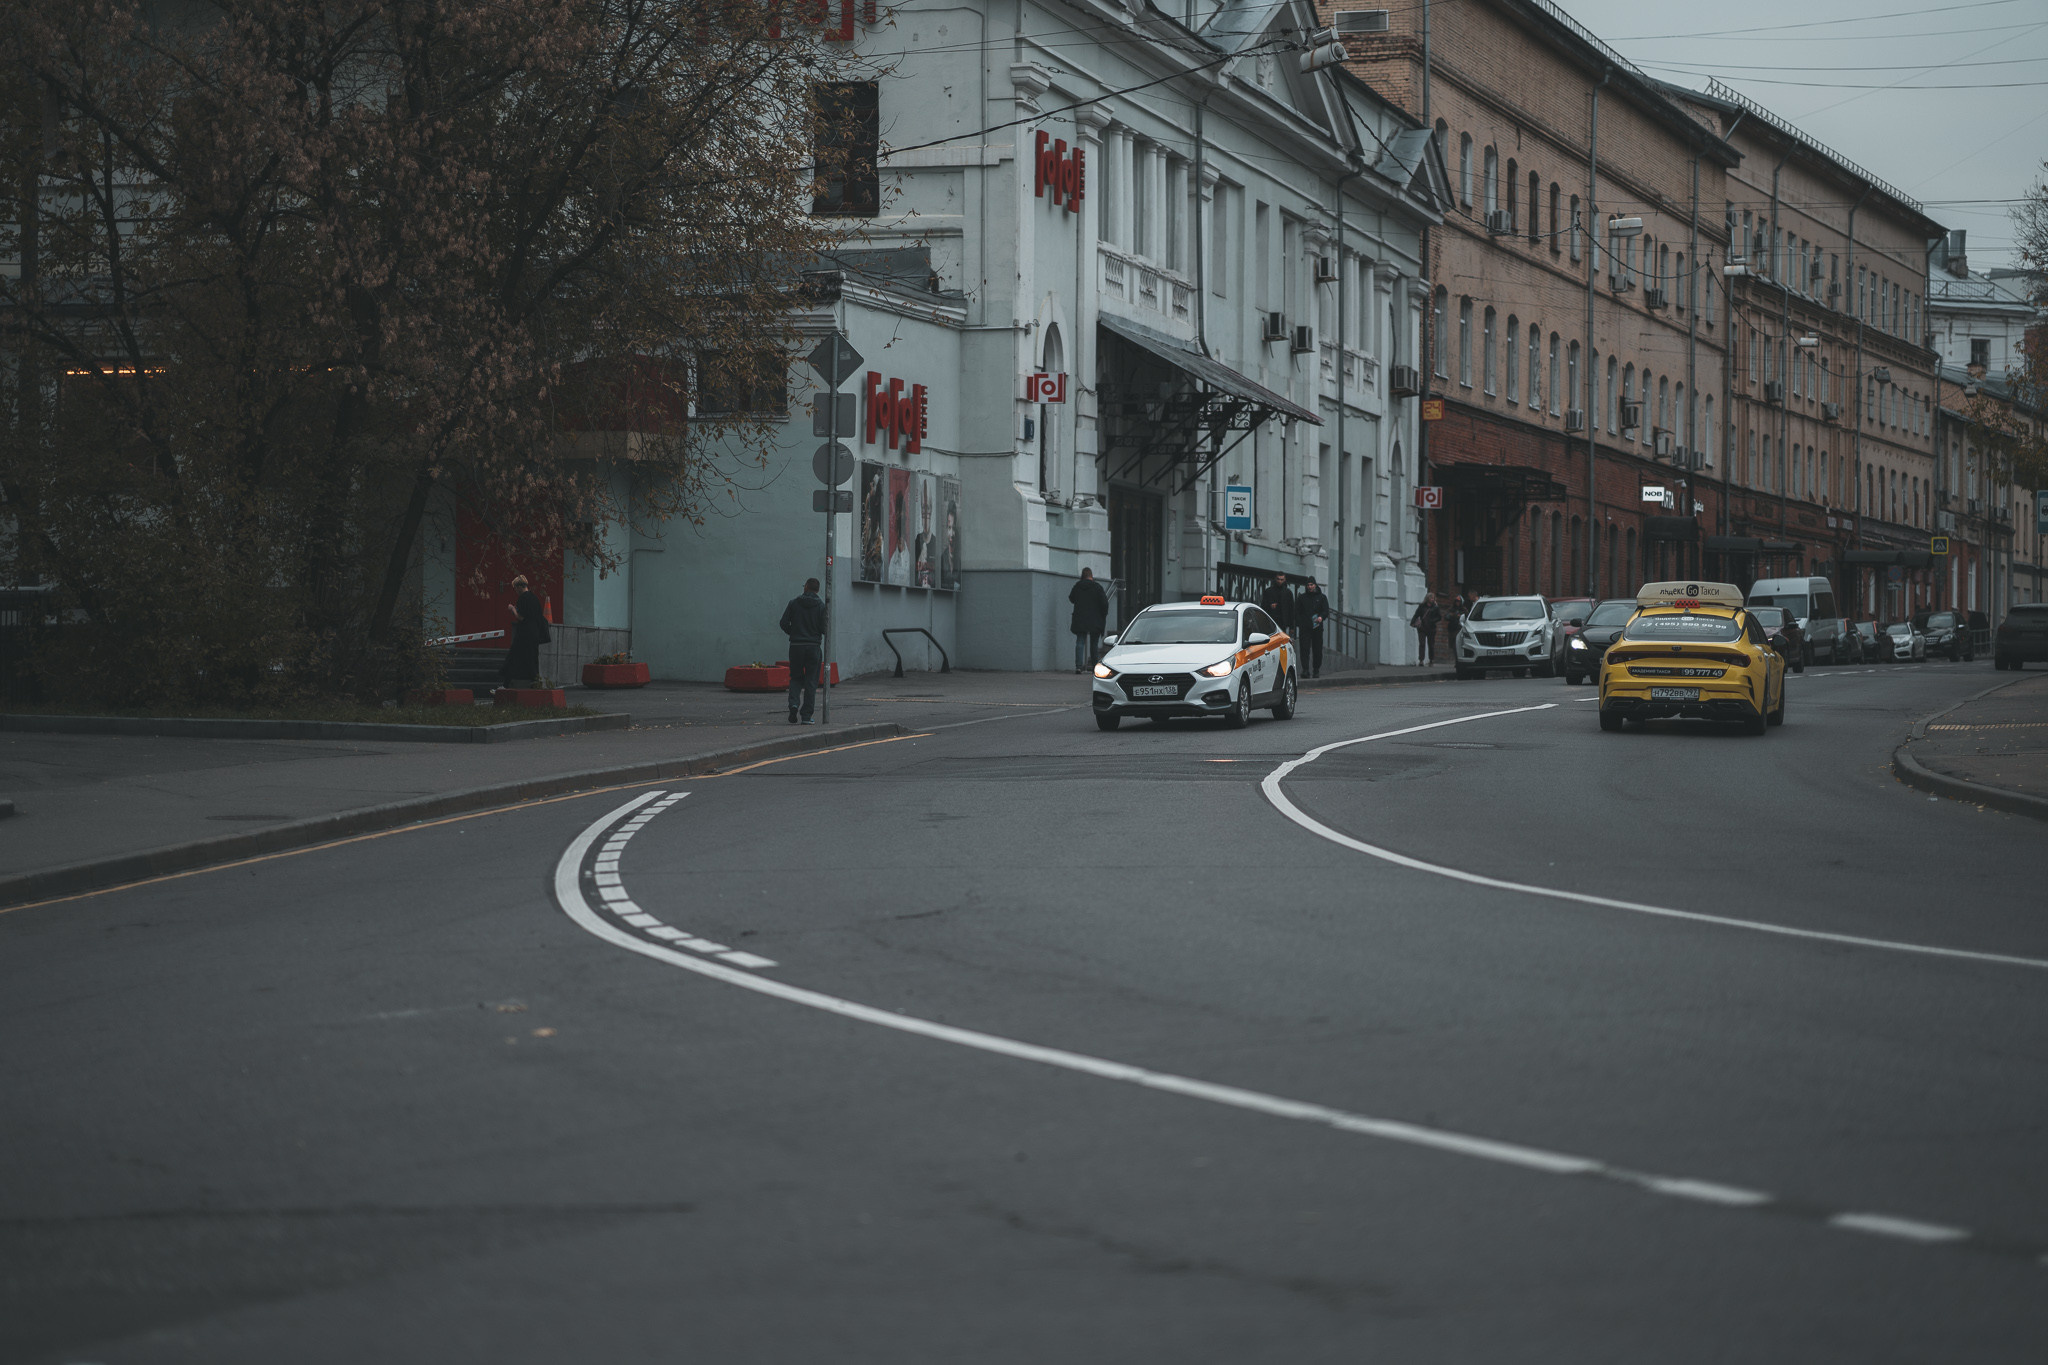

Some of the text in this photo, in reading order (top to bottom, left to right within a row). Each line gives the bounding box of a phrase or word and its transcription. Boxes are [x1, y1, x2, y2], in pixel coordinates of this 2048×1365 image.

[1424, 402, 1441, 413] 24
[1687, 585, 1698, 595] Go
[1701, 586, 1720, 595] Такси
[1696, 669, 1711, 677] 777
